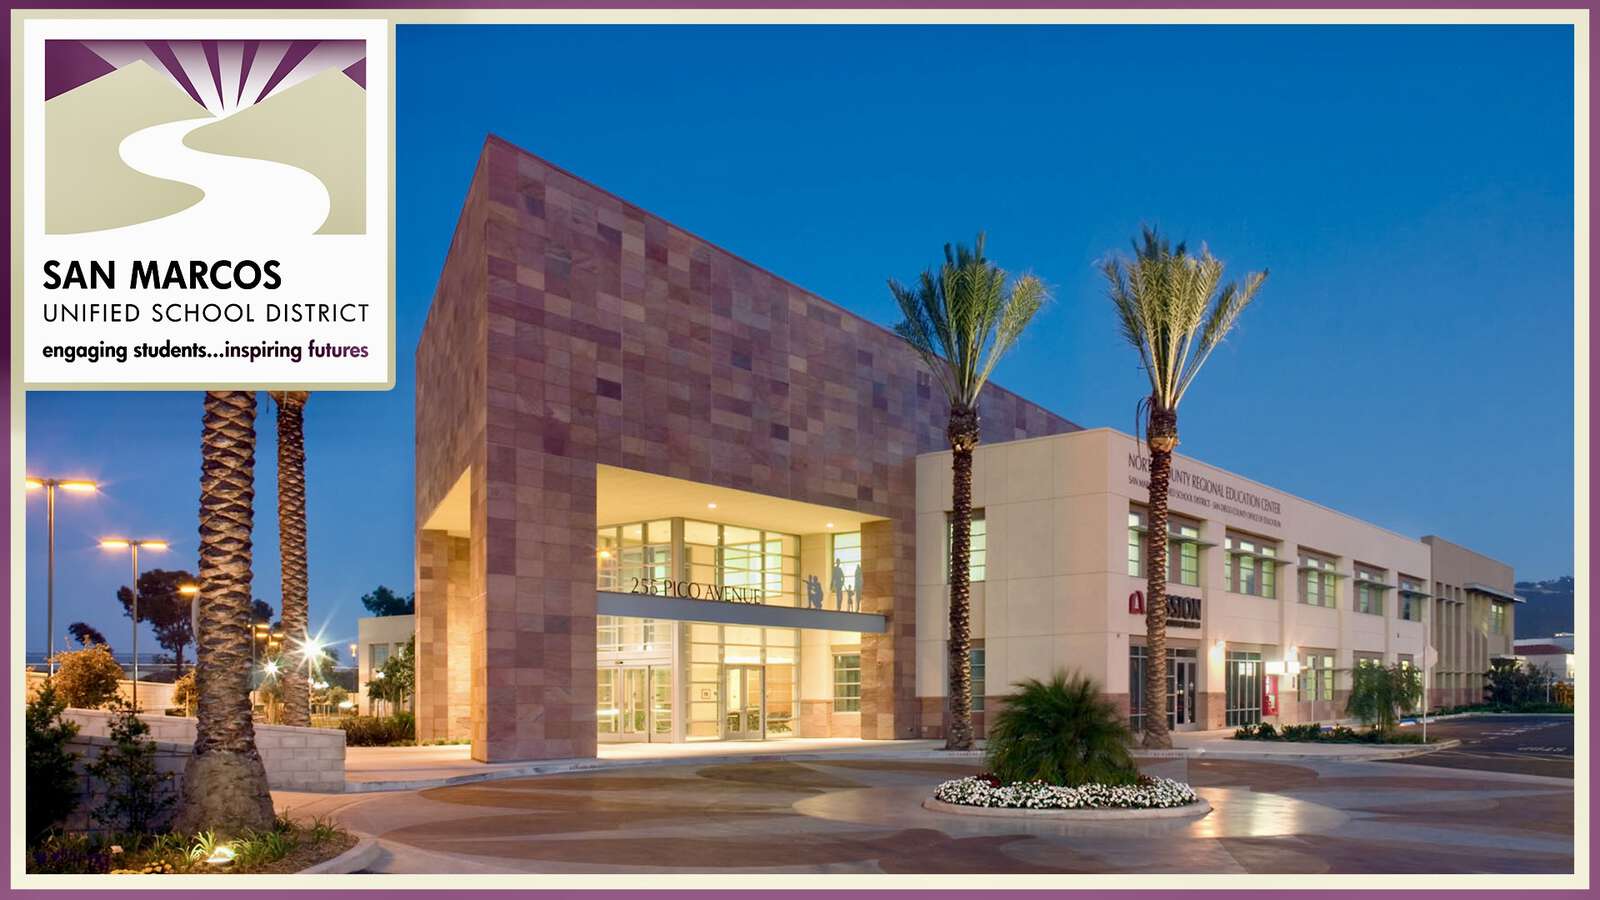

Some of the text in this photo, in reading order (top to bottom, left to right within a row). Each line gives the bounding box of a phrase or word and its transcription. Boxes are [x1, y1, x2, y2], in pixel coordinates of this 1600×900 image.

[1192, 475, 1225, 498] REGIONAL
[1225, 486, 1261, 509] EDUCATION
[1261, 498, 1281, 515] CENTER
[663, 579, 701, 599] PICO
[705, 584, 761, 605] AVENUE
